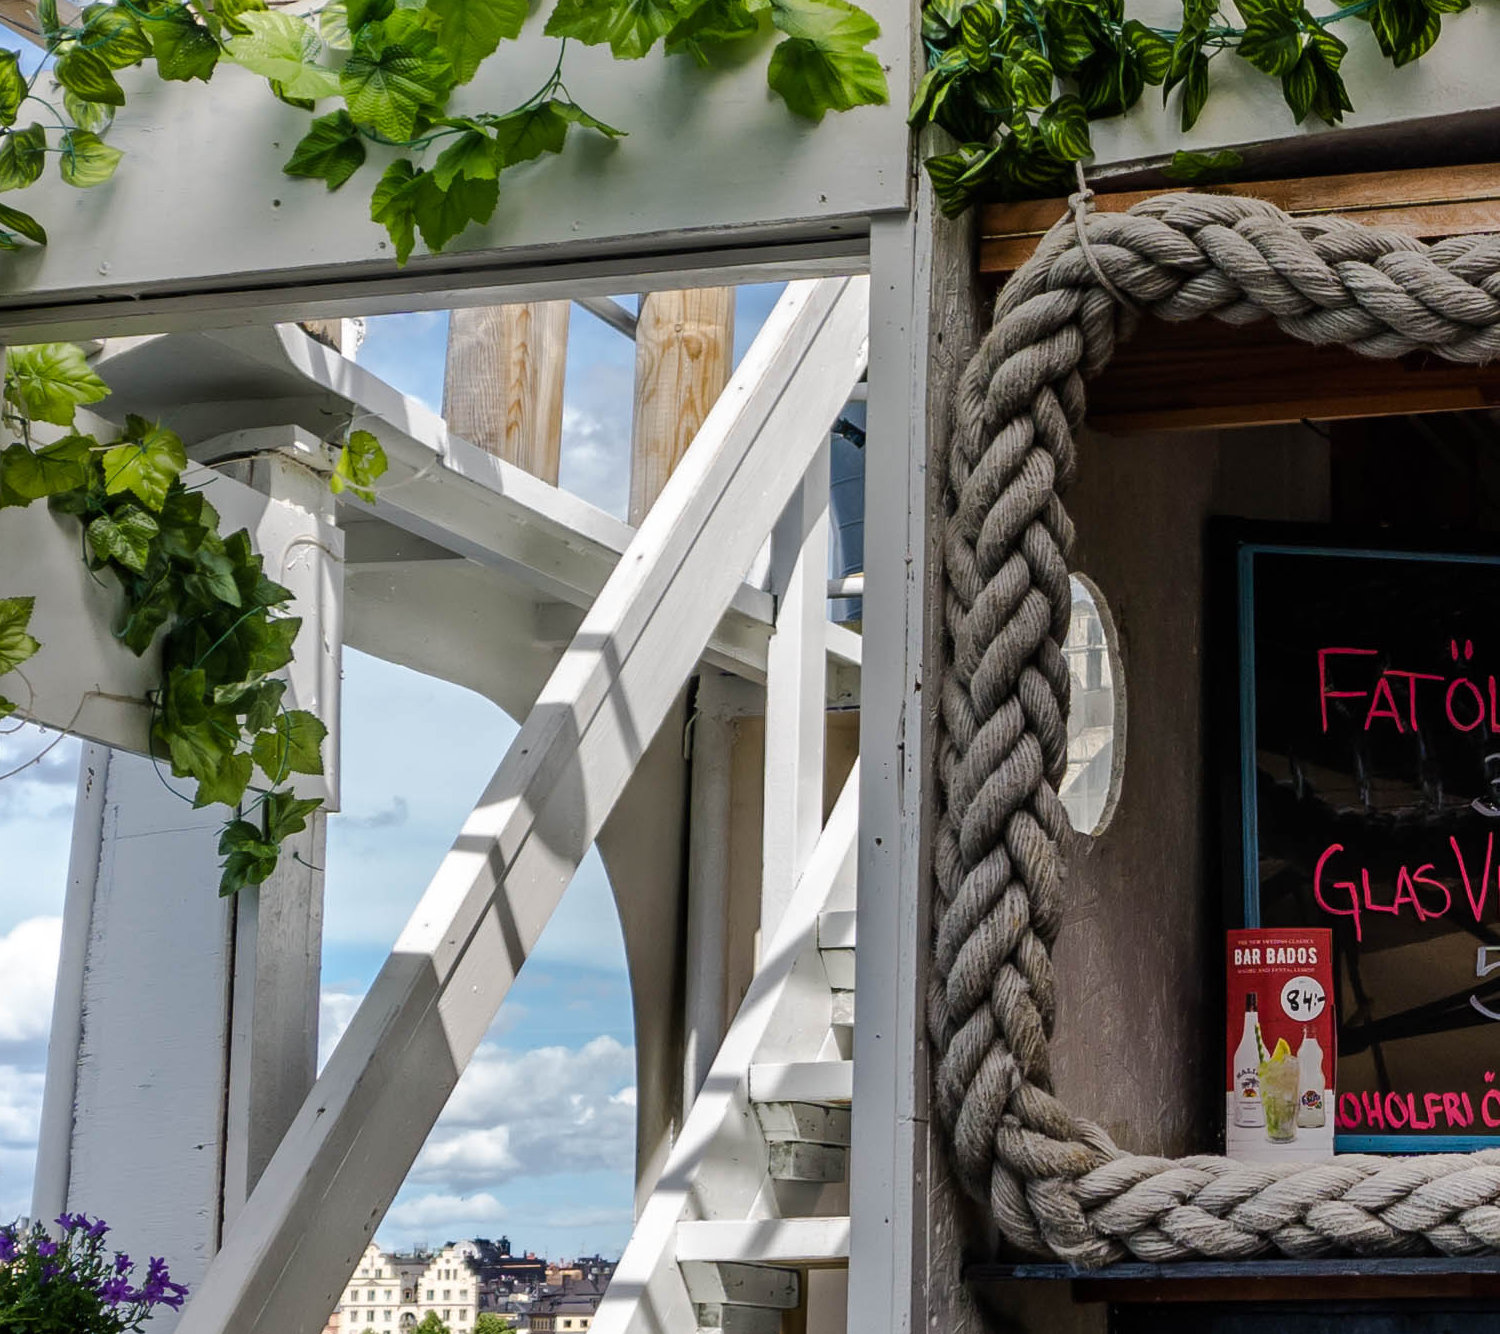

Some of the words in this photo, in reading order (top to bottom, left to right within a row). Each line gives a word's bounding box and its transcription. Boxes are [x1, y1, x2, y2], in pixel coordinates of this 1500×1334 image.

[1313, 842, 1452, 943] GLAS
[1233, 947, 1261, 966] BAR
[1266, 947, 1318, 965] BADOS
[1335, 1090, 1476, 1131] OHOLFRI
